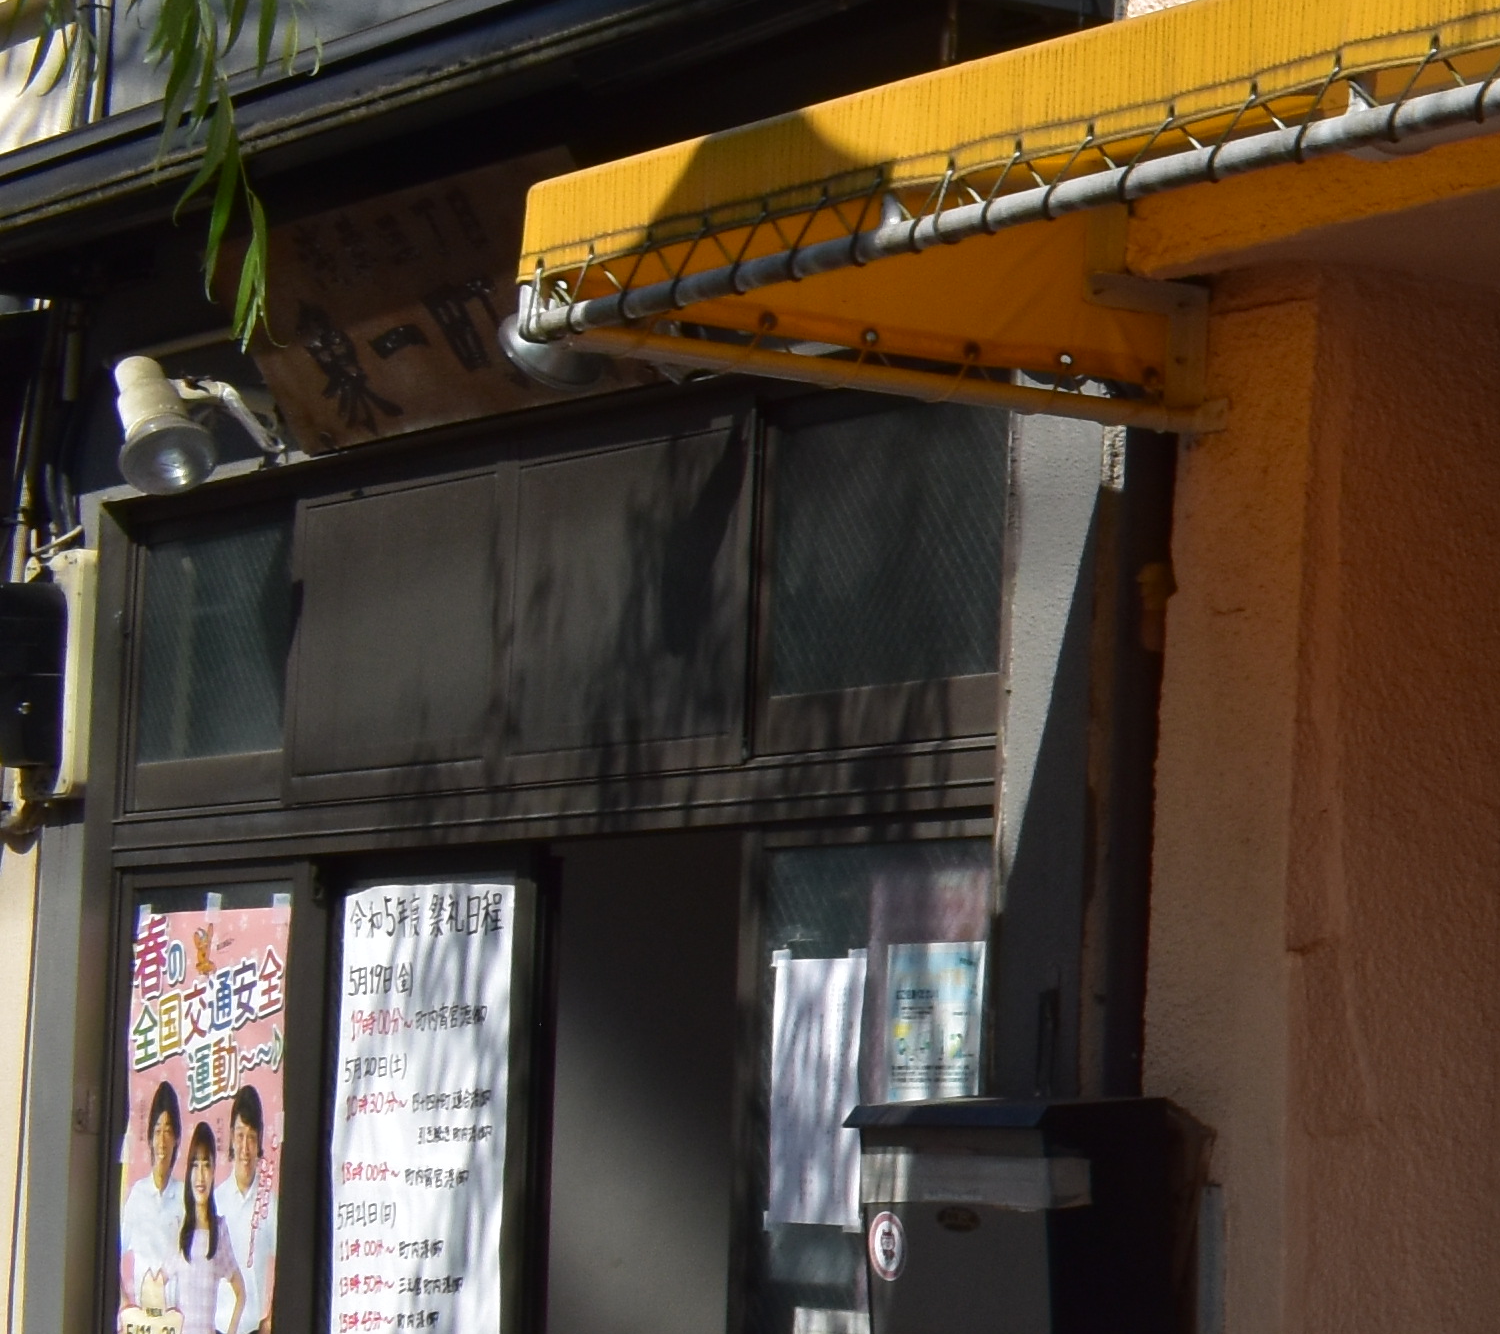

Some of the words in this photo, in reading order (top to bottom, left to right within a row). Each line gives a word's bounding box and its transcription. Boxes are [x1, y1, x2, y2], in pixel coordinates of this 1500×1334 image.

[351, 893, 420, 938] 令和5年度
[428, 890, 504, 938] 祭礼日程
[133, 914, 186, 1000] 春の
[348, 961, 414, 997] 5月19日(金)
[133, 945, 284, 1072] 全国交通安全
[344, 1052, 408, 1083] 5月20日(土)
